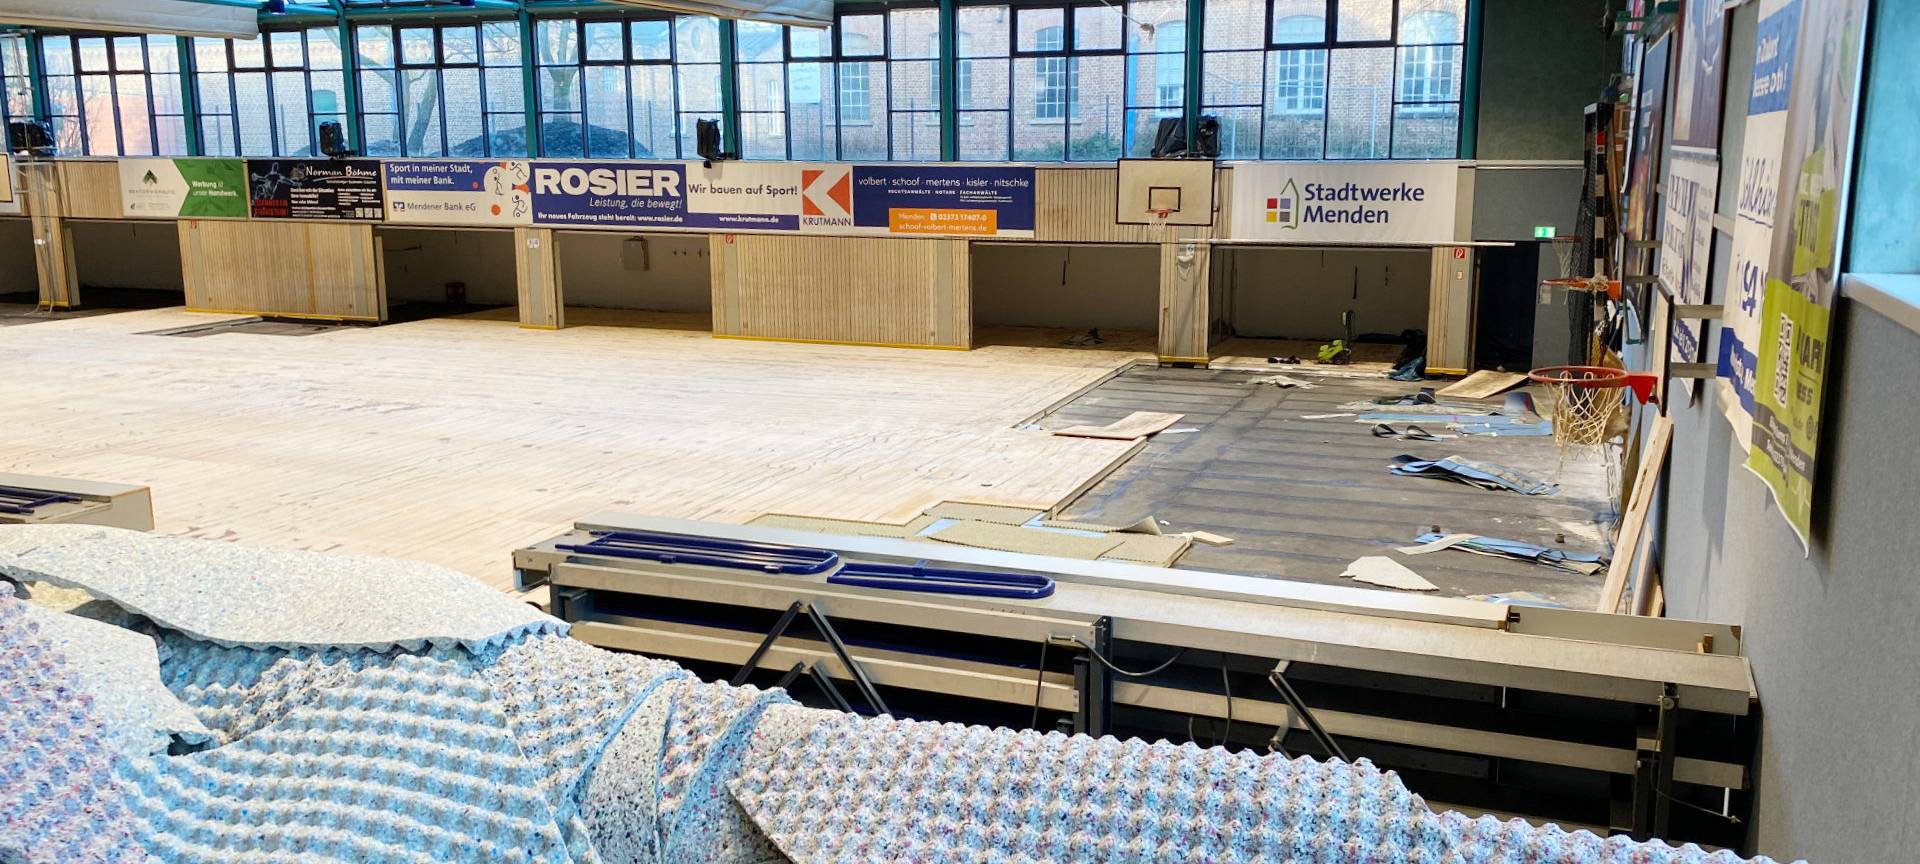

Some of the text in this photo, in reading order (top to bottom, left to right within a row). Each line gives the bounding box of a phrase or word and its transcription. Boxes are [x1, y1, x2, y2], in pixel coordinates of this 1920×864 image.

[305, 166, 342, 176] Norman
[390, 163, 473, 174] Sport in meiner Stadt,
[192, 181, 217, 189] Werbung
[391, 176, 455, 185] mit meiner Bank.
[534, 167, 681, 197] ROSIER
[859, 176, 1029, 188] volbert schoof mertens kisler nitschke
[688, 183, 798, 198] Wir bauen auf Sport!
[1304, 182, 1425, 202] Stadtwerke
[407, 202, 476, 211] Mendener Bank eG
[589, 197, 682, 210] Leistung, die bewegt!
[1303, 204, 1389, 224] Menden
[802, 217, 851, 226] KRUTMANN
